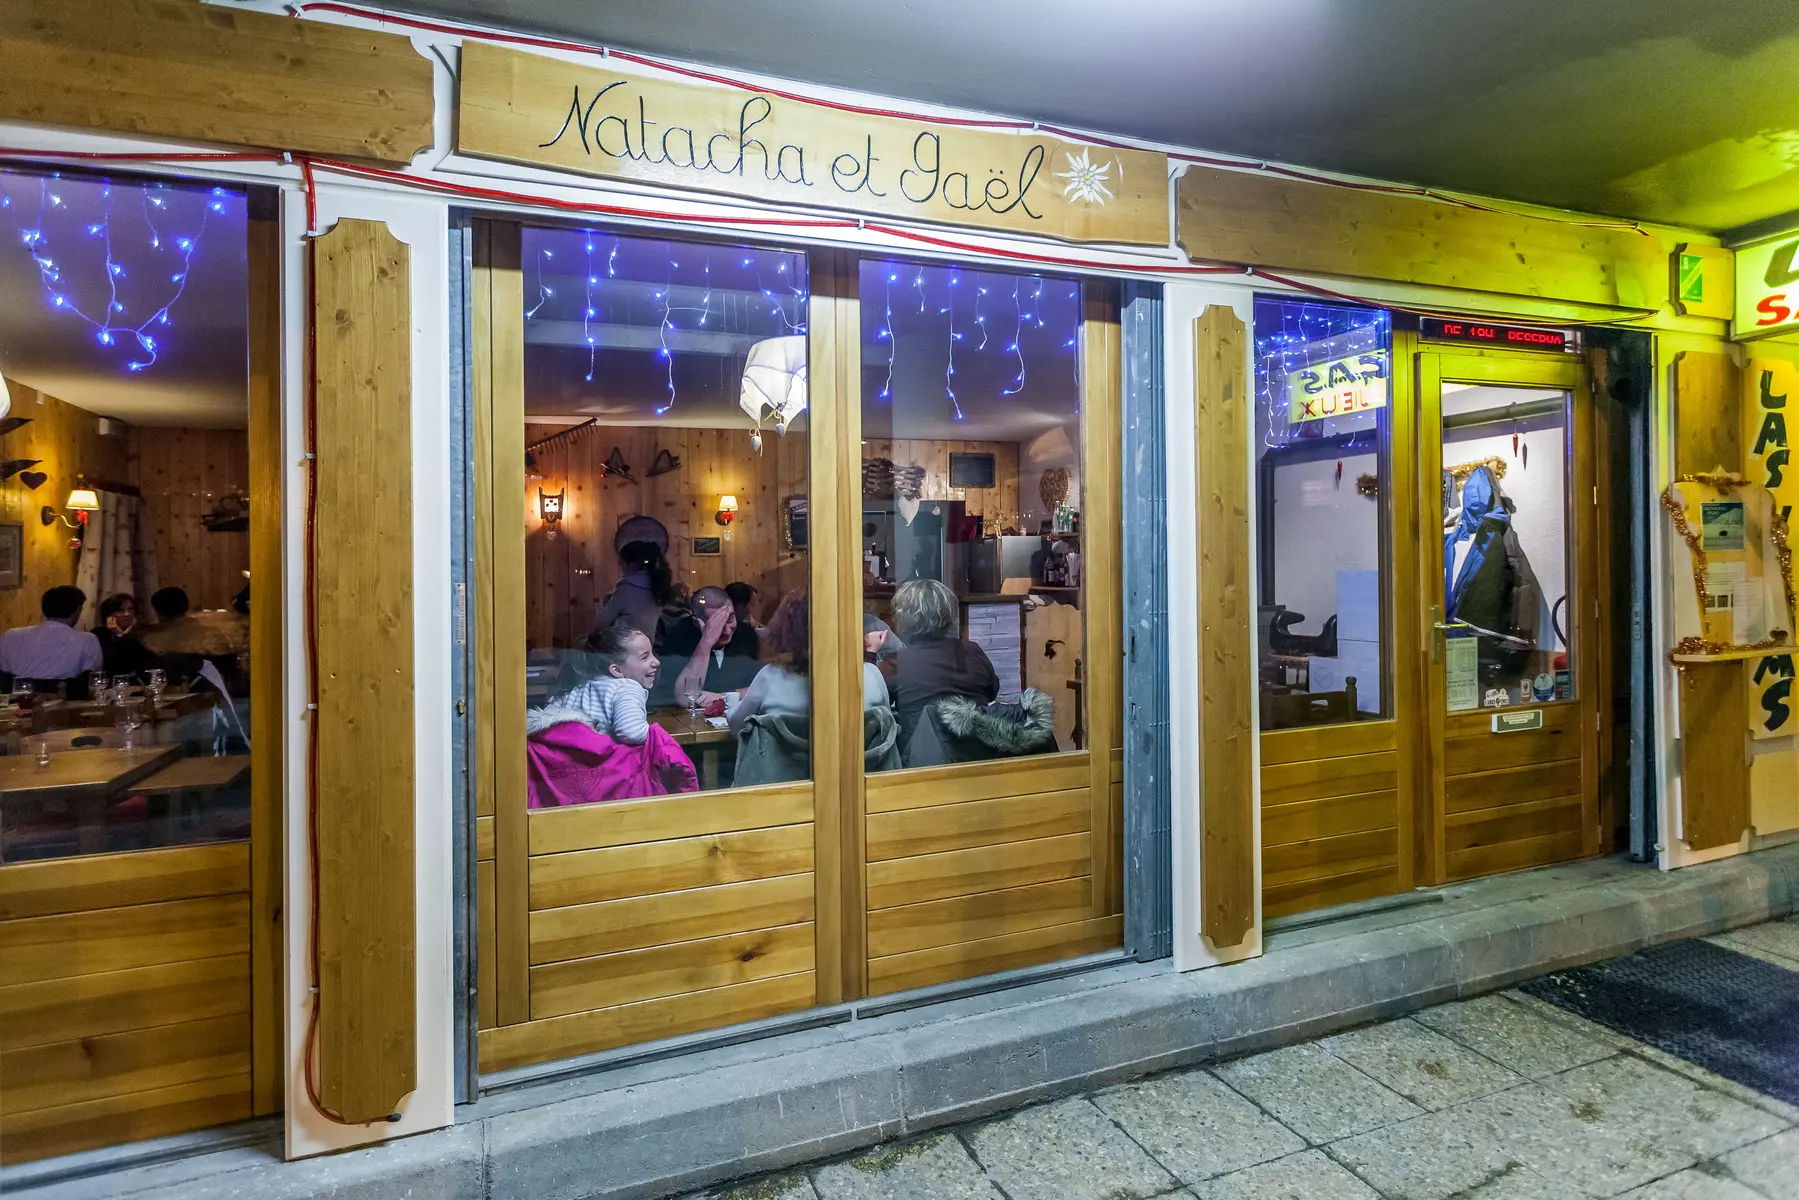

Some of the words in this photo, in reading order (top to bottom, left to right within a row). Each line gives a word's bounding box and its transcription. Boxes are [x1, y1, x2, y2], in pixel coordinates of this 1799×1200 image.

[538, 80, 814, 187] Natacha
[831, 133, 887, 198] et
[1755, 293, 1799, 327] S
[1753, 369, 1790, 489] LAS
